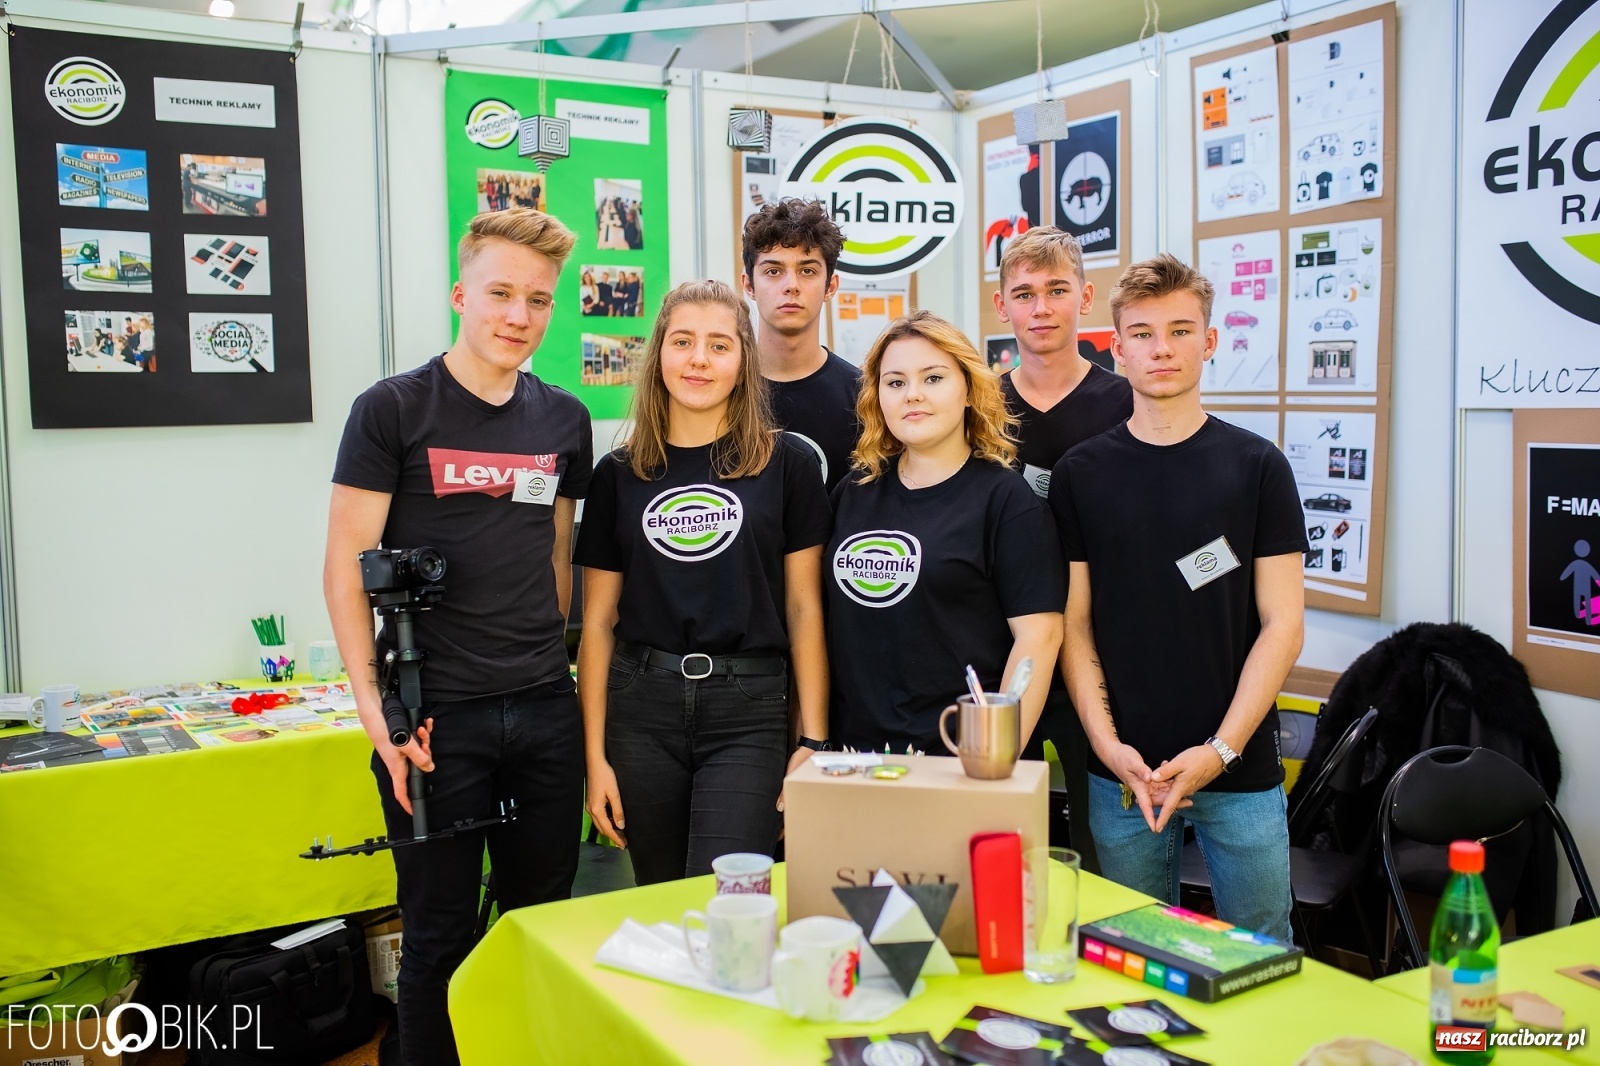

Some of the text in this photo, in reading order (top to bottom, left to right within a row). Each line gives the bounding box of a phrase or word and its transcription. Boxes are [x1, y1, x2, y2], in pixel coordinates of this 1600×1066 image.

[49, 84, 122, 98] ekonomik
[169, 96, 262, 110] TECHNIK REKLAMY
[567, 111, 639, 125] TECHNIK REKLAMY
[85, 152, 117, 162] MEDIA
[63, 157, 97, 173] INTERNET
[75, 174, 97, 187] RADIO
[106, 168, 143, 182] TELEVISION
[62, 187, 98, 199] MAGAZINES
[107, 187, 146, 205] NEWSPAPERS
[820, 192, 955, 223] klama
[1561, 194, 1600, 225] R
[212, 331, 251, 339] SOCIAL
[214, 340, 249, 348] MEDIA
[647, 507, 738, 528] ekonomik
[666, 522, 719, 535] RACIBÓRZ
[837, 557, 915, 573] ekonomik
[853, 570, 897, 580] RACIBÓRZ
